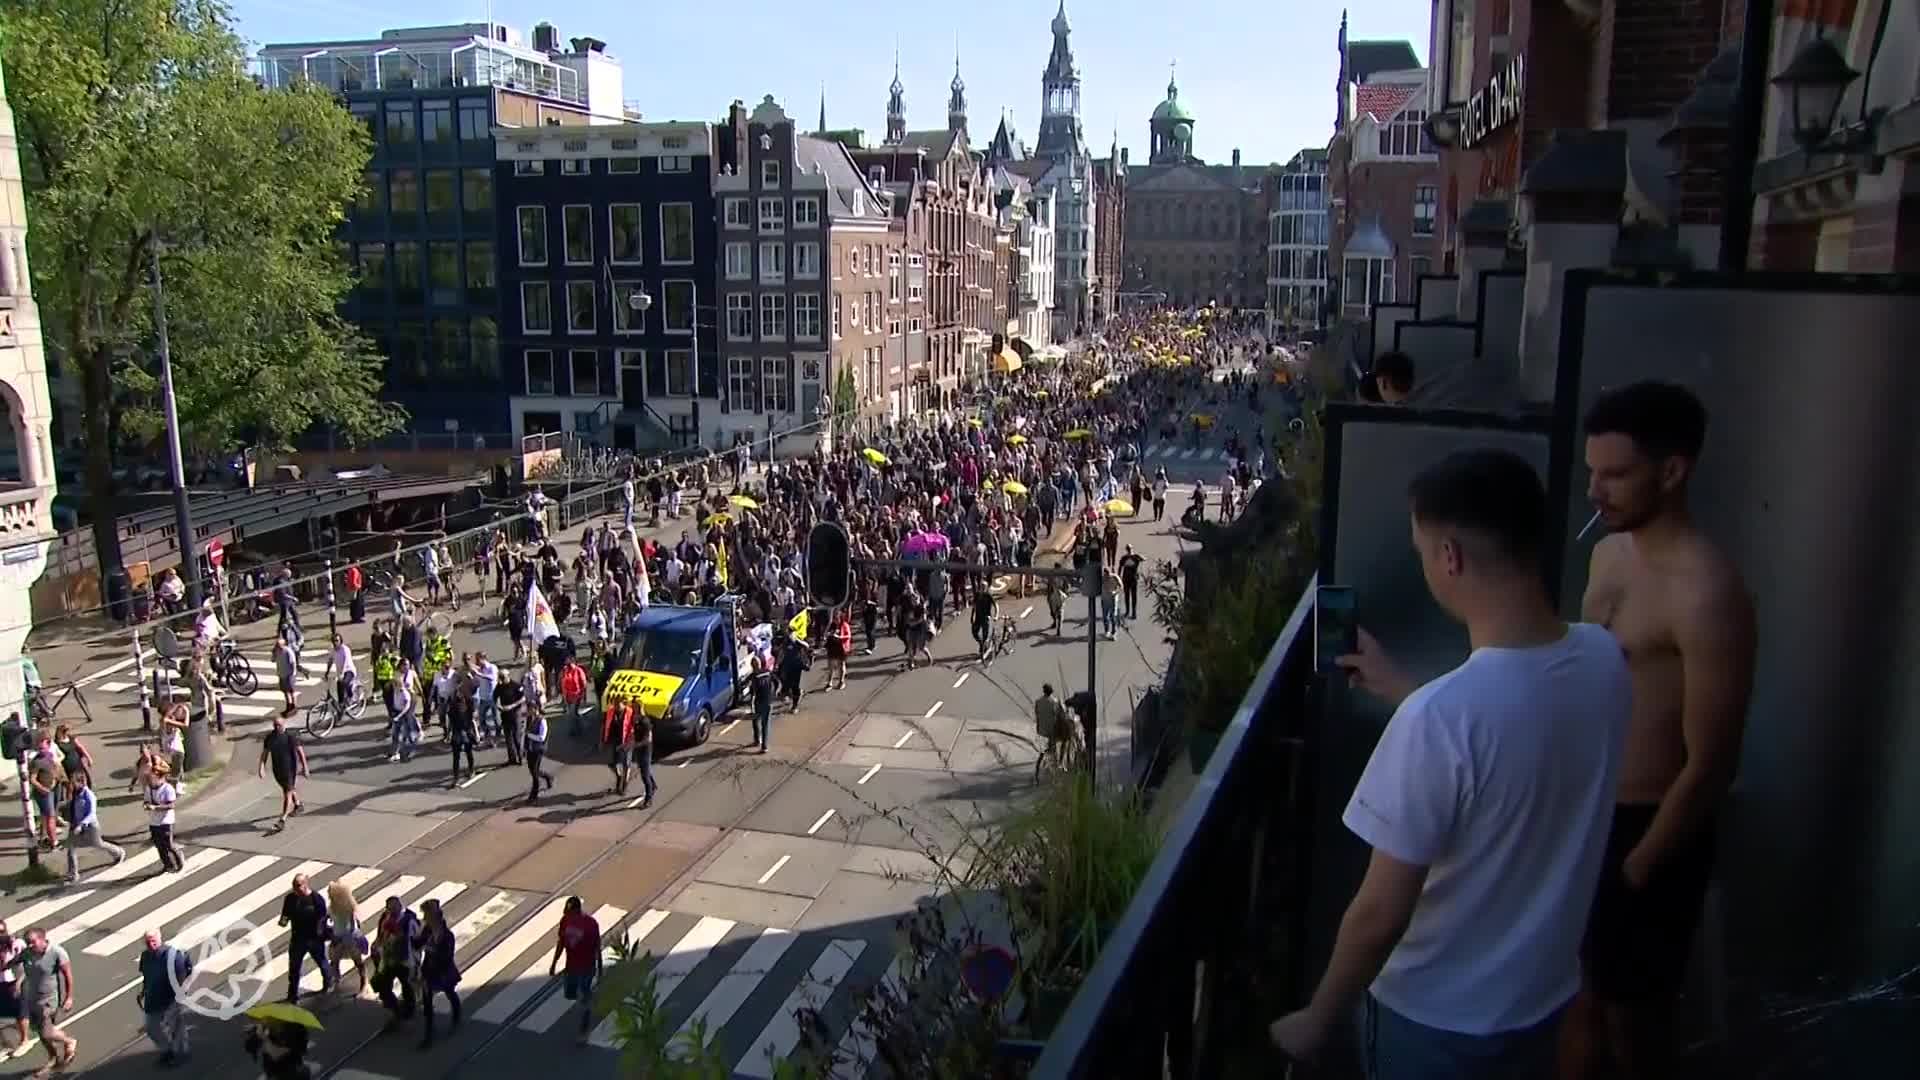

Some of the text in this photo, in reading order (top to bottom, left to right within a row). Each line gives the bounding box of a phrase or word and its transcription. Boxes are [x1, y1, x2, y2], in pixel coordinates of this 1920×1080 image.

[1459, 88, 1487, 151] HOTEL
[615, 673, 648, 685] HET
[608, 683, 663, 697] KLOPT
